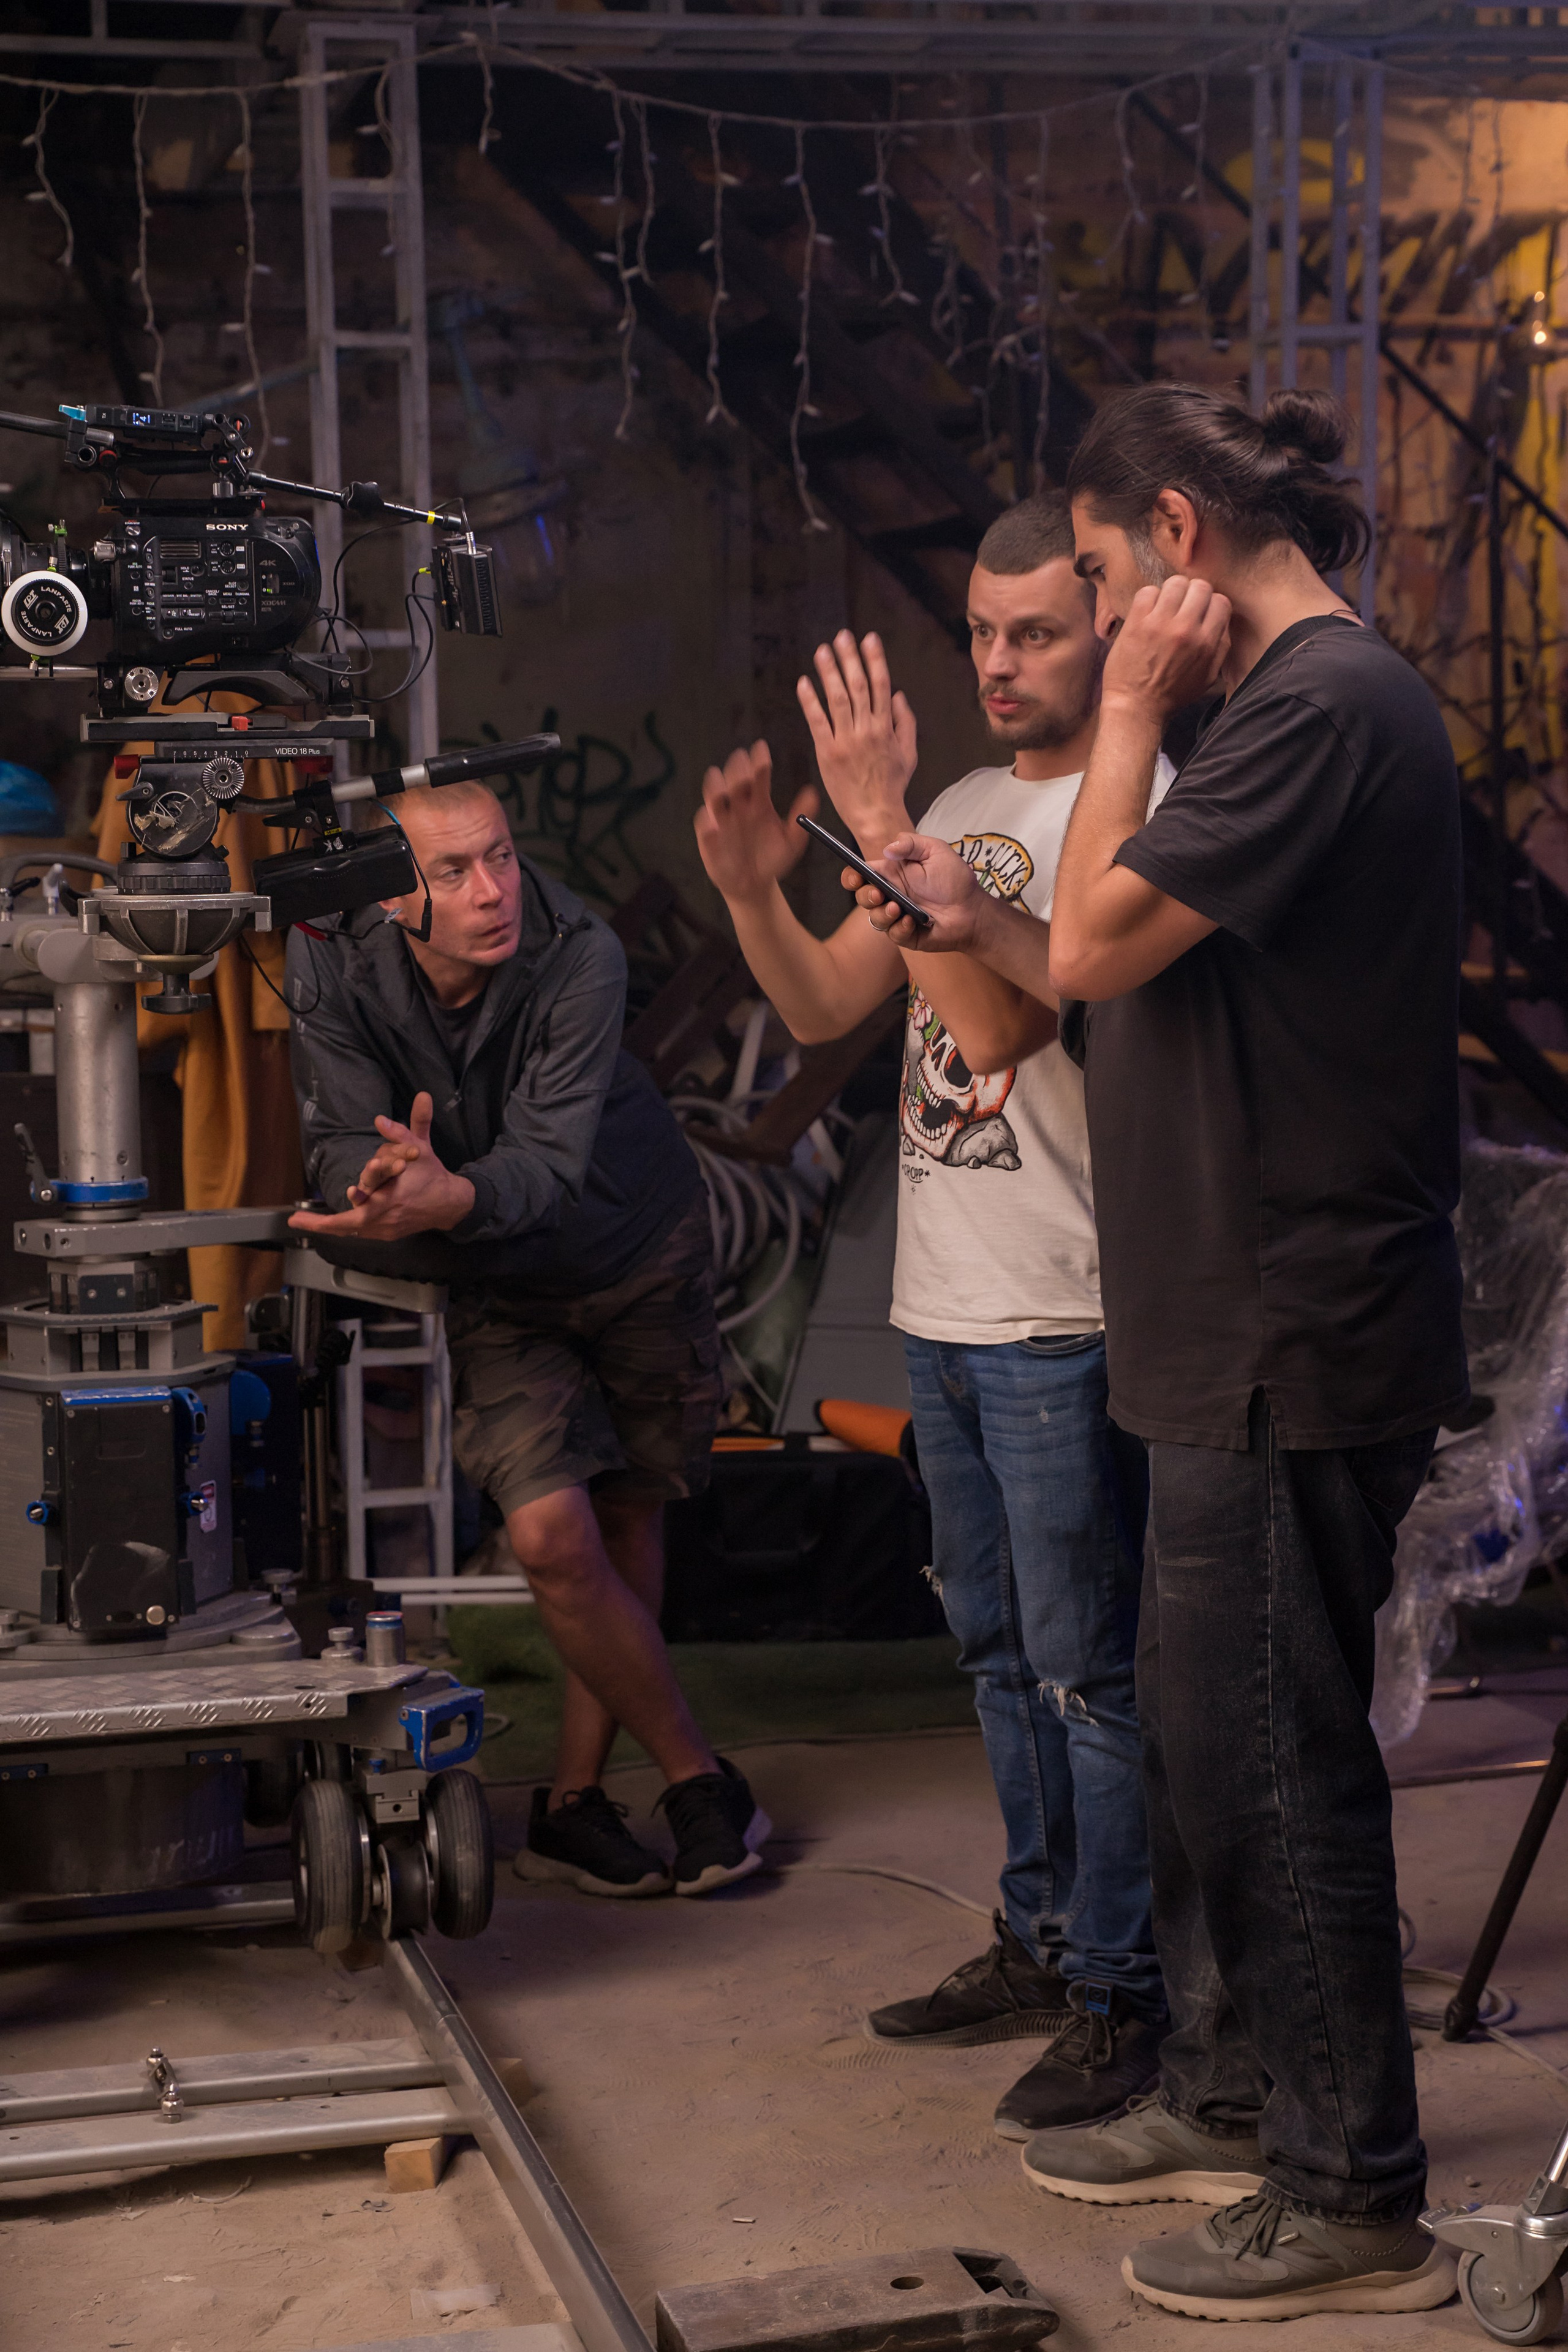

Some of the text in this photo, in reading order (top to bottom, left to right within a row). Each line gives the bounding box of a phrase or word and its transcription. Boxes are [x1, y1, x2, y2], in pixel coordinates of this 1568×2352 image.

[40, 586, 72, 612] LANPARTE
[21, 610, 52, 637] LANPARTE
[985, 842, 1029, 891] LUCK
[904, 1164, 924, 1183] CROPP
